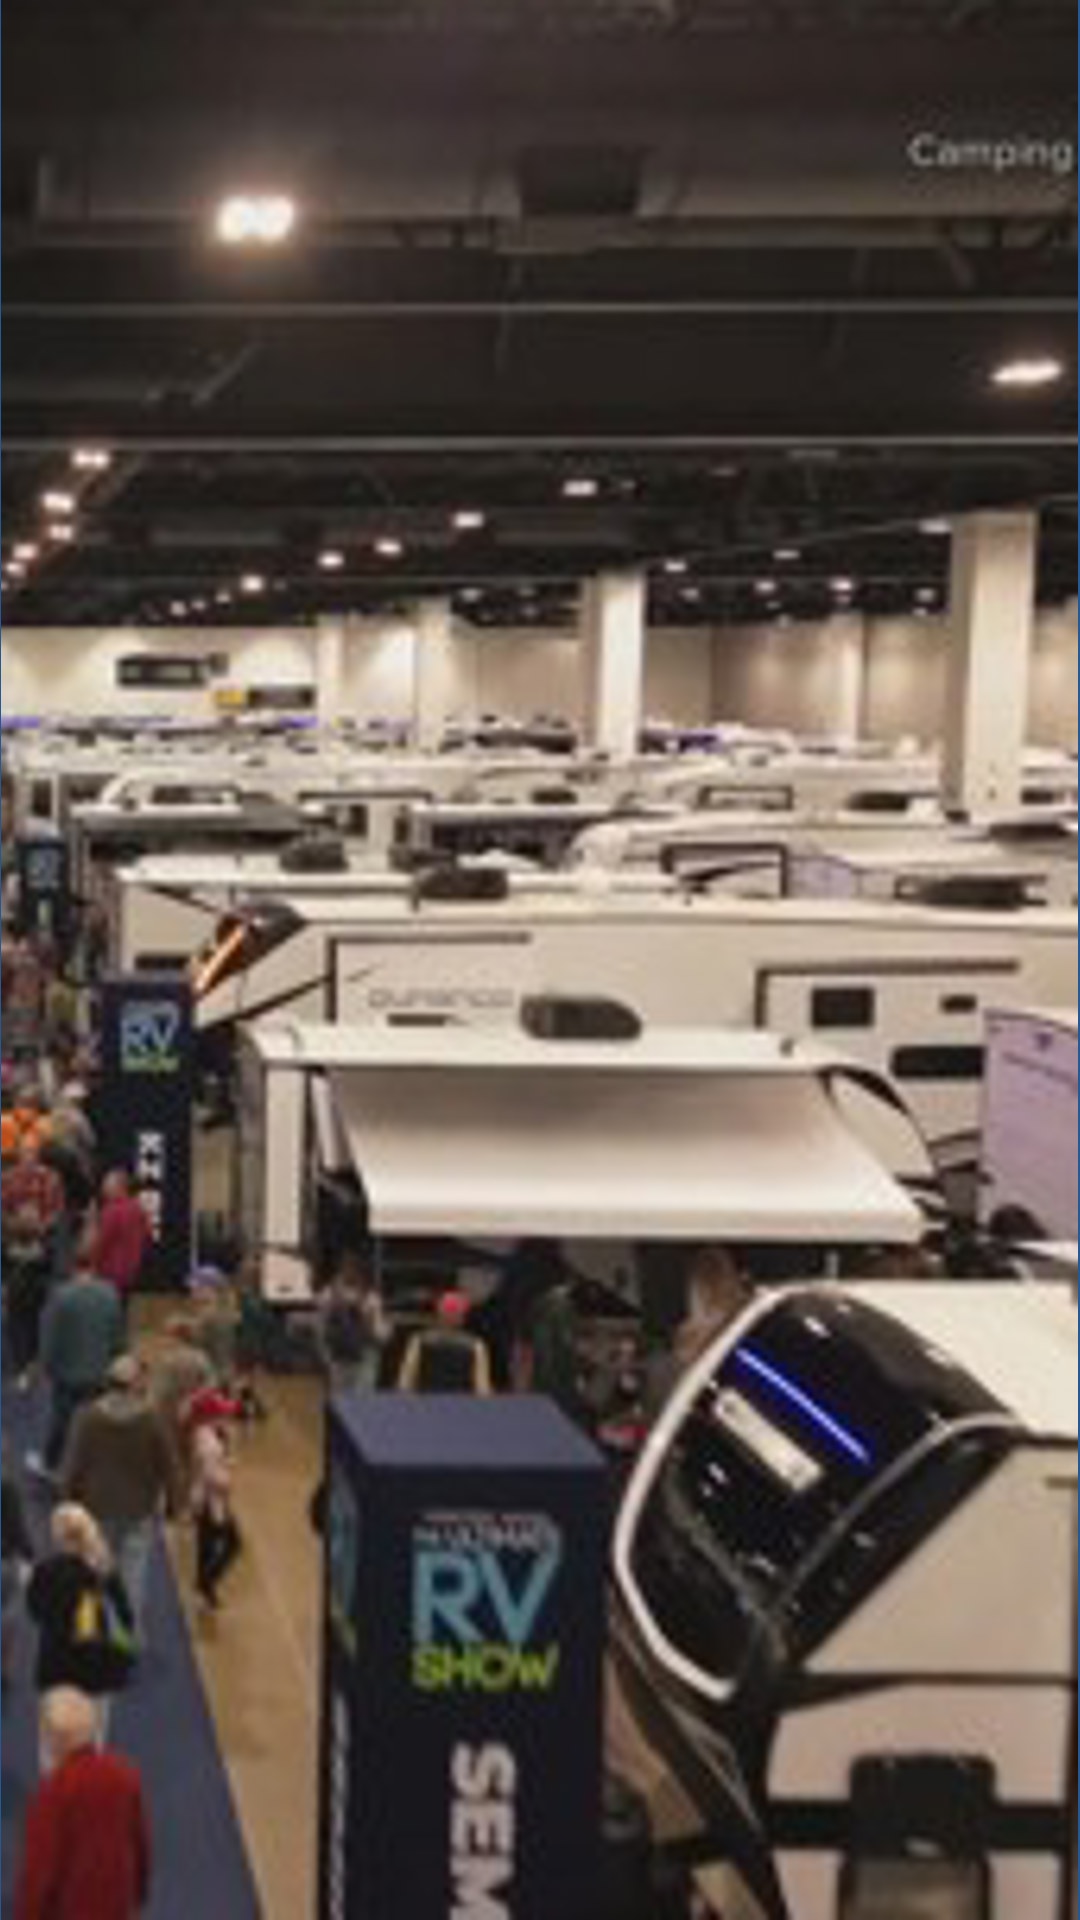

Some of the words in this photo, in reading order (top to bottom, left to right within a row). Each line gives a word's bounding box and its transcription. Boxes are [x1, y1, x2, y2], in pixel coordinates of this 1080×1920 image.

[121, 1008, 178, 1053] RV
[412, 1546, 560, 1644] RV
[412, 1644, 559, 1689] SHOW
[450, 1742, 516, 1920] SEM
